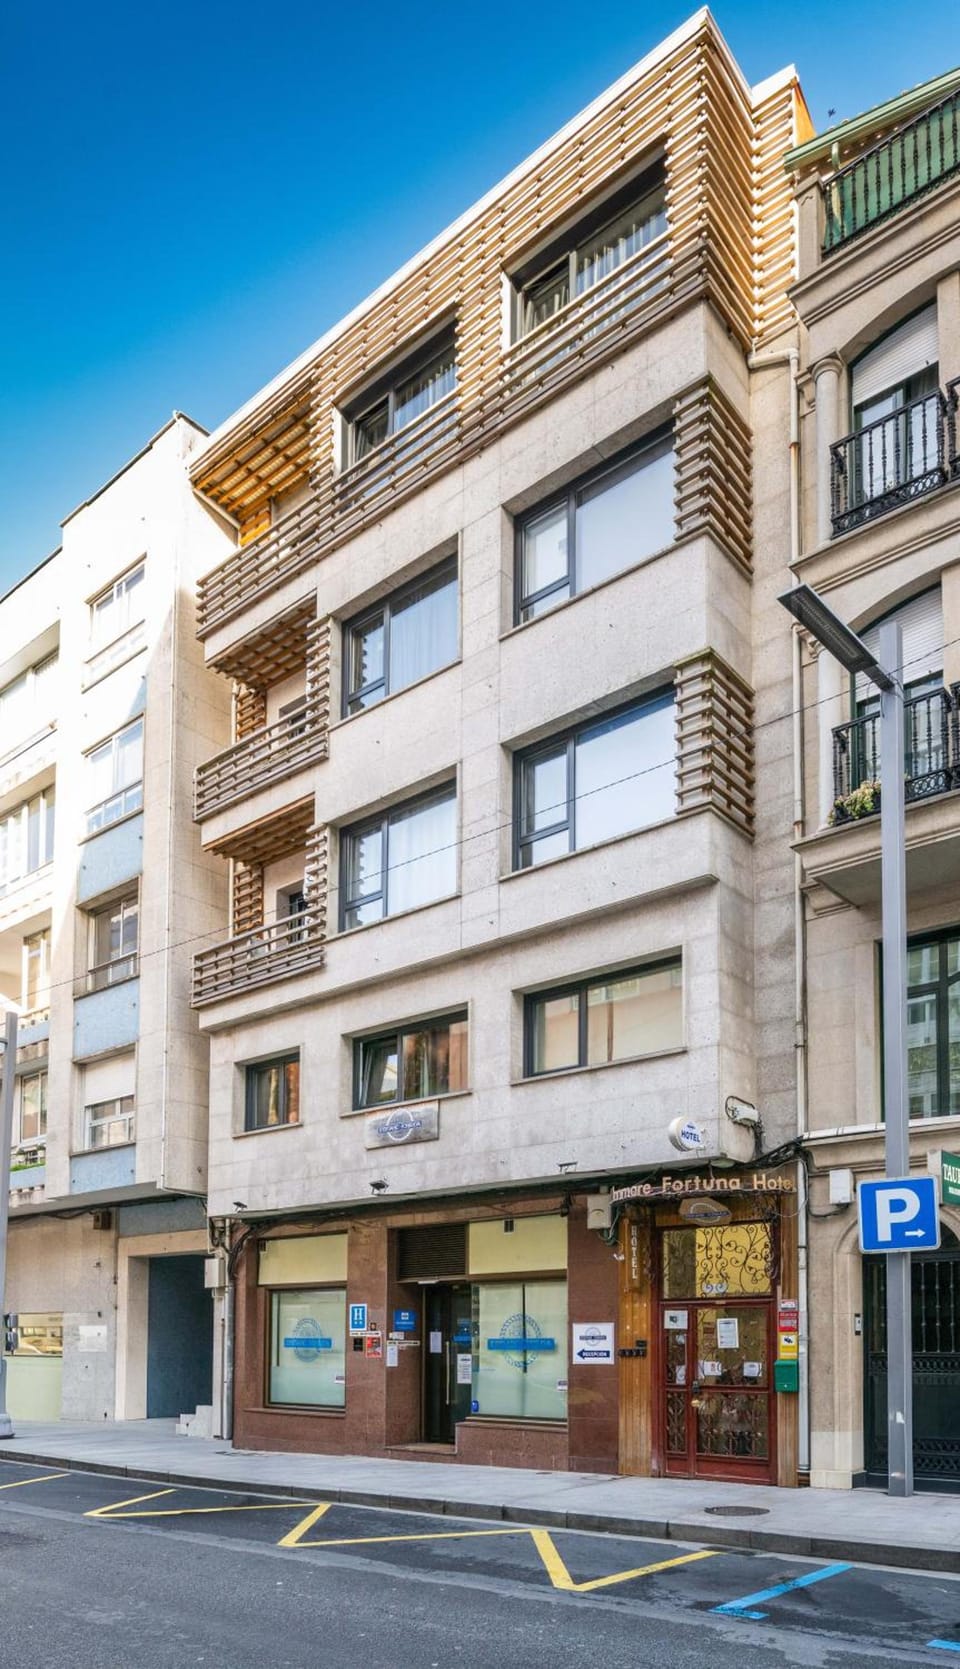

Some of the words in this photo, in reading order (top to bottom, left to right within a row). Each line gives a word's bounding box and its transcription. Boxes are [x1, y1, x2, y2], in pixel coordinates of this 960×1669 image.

[681, 1130, 701, 1142] HOTEL
[662, 1175, 741, 1193] Fortuna
[875, 1187, 921, 1242] P
[354, 1307, 364, 1321] H
